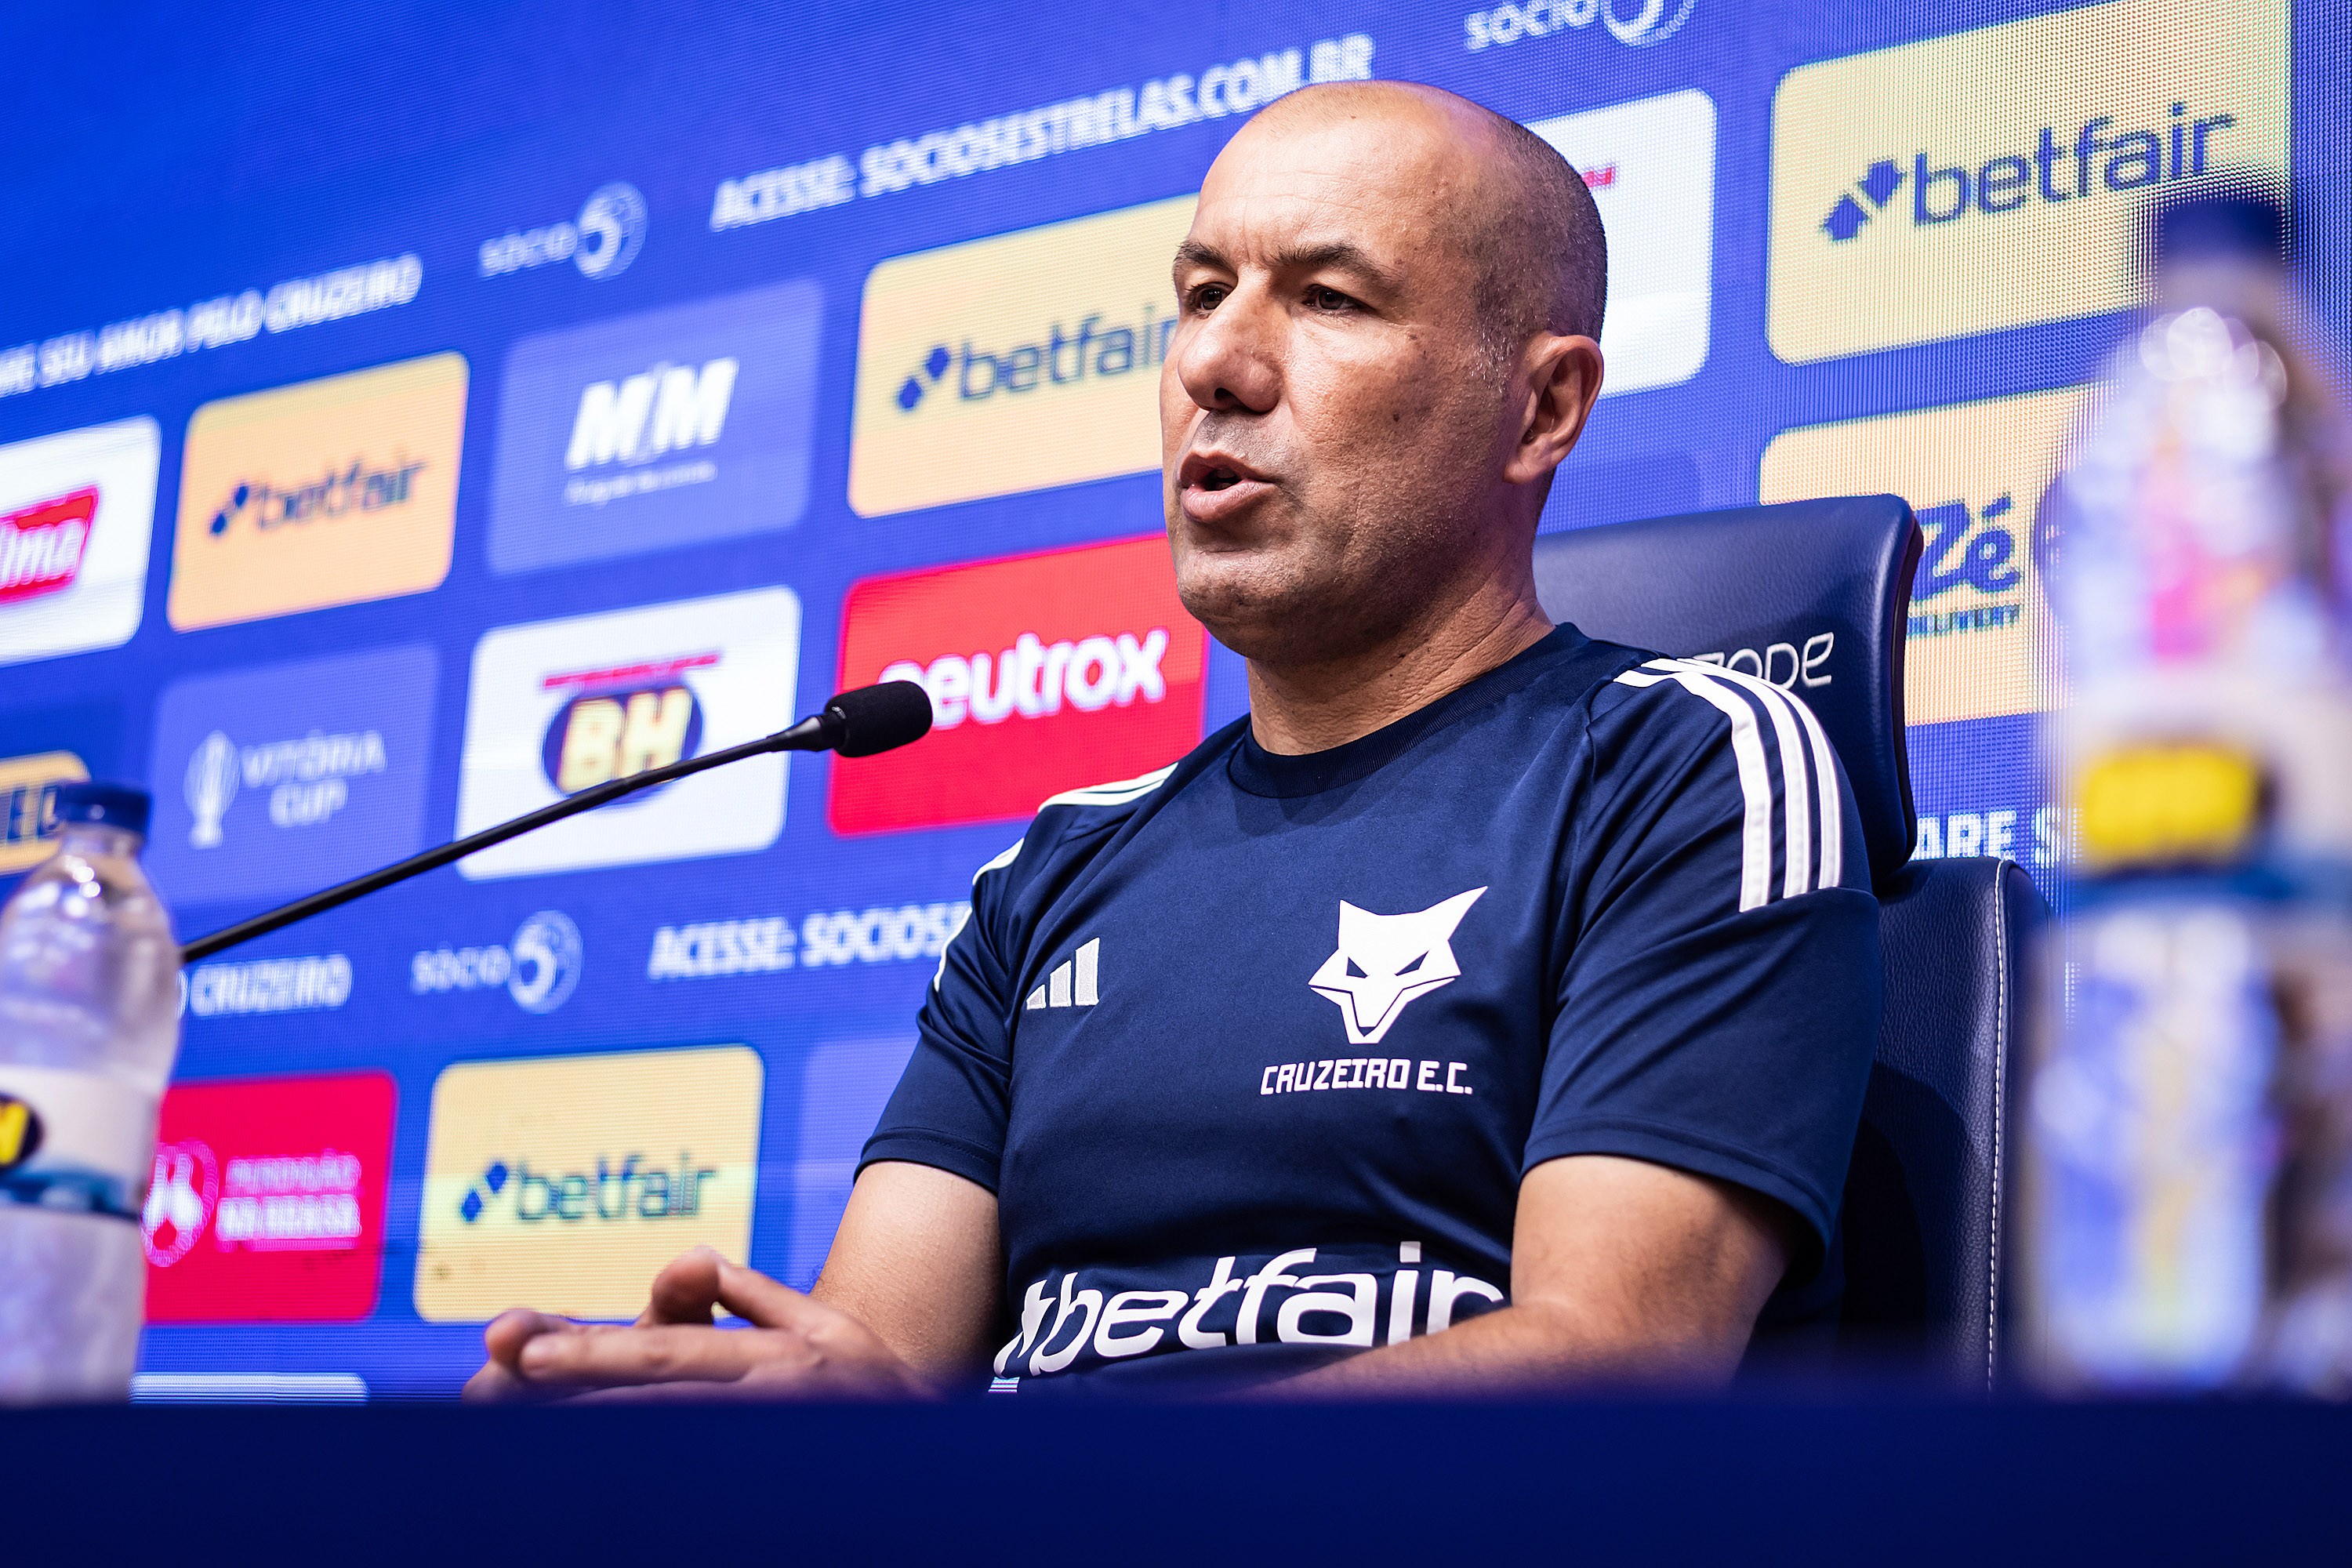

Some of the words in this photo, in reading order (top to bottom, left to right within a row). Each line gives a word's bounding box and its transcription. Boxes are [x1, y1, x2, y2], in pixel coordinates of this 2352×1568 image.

[1913, 99, 2239, 228] betfair
[263, 250, 424, 336] CRUZEIRO
[256, 449, 430, 532] betfair
[1911, 491, 2020, 604] Zé
[555, 684, 691, 795] BH
[268, 776, 349, 829] CUP
[189, 952, 354, 1018] CRUZEIRO
[647, 915, 798, 982] ACESSE:
[1259, 1058, 1411, 1096] CRUZEIRO
[1416, 1059, 1474, 1095] E.C.
[517, 1149, 718, 1221] betfair
[1029, 1240, 1504, 1377] betfair
